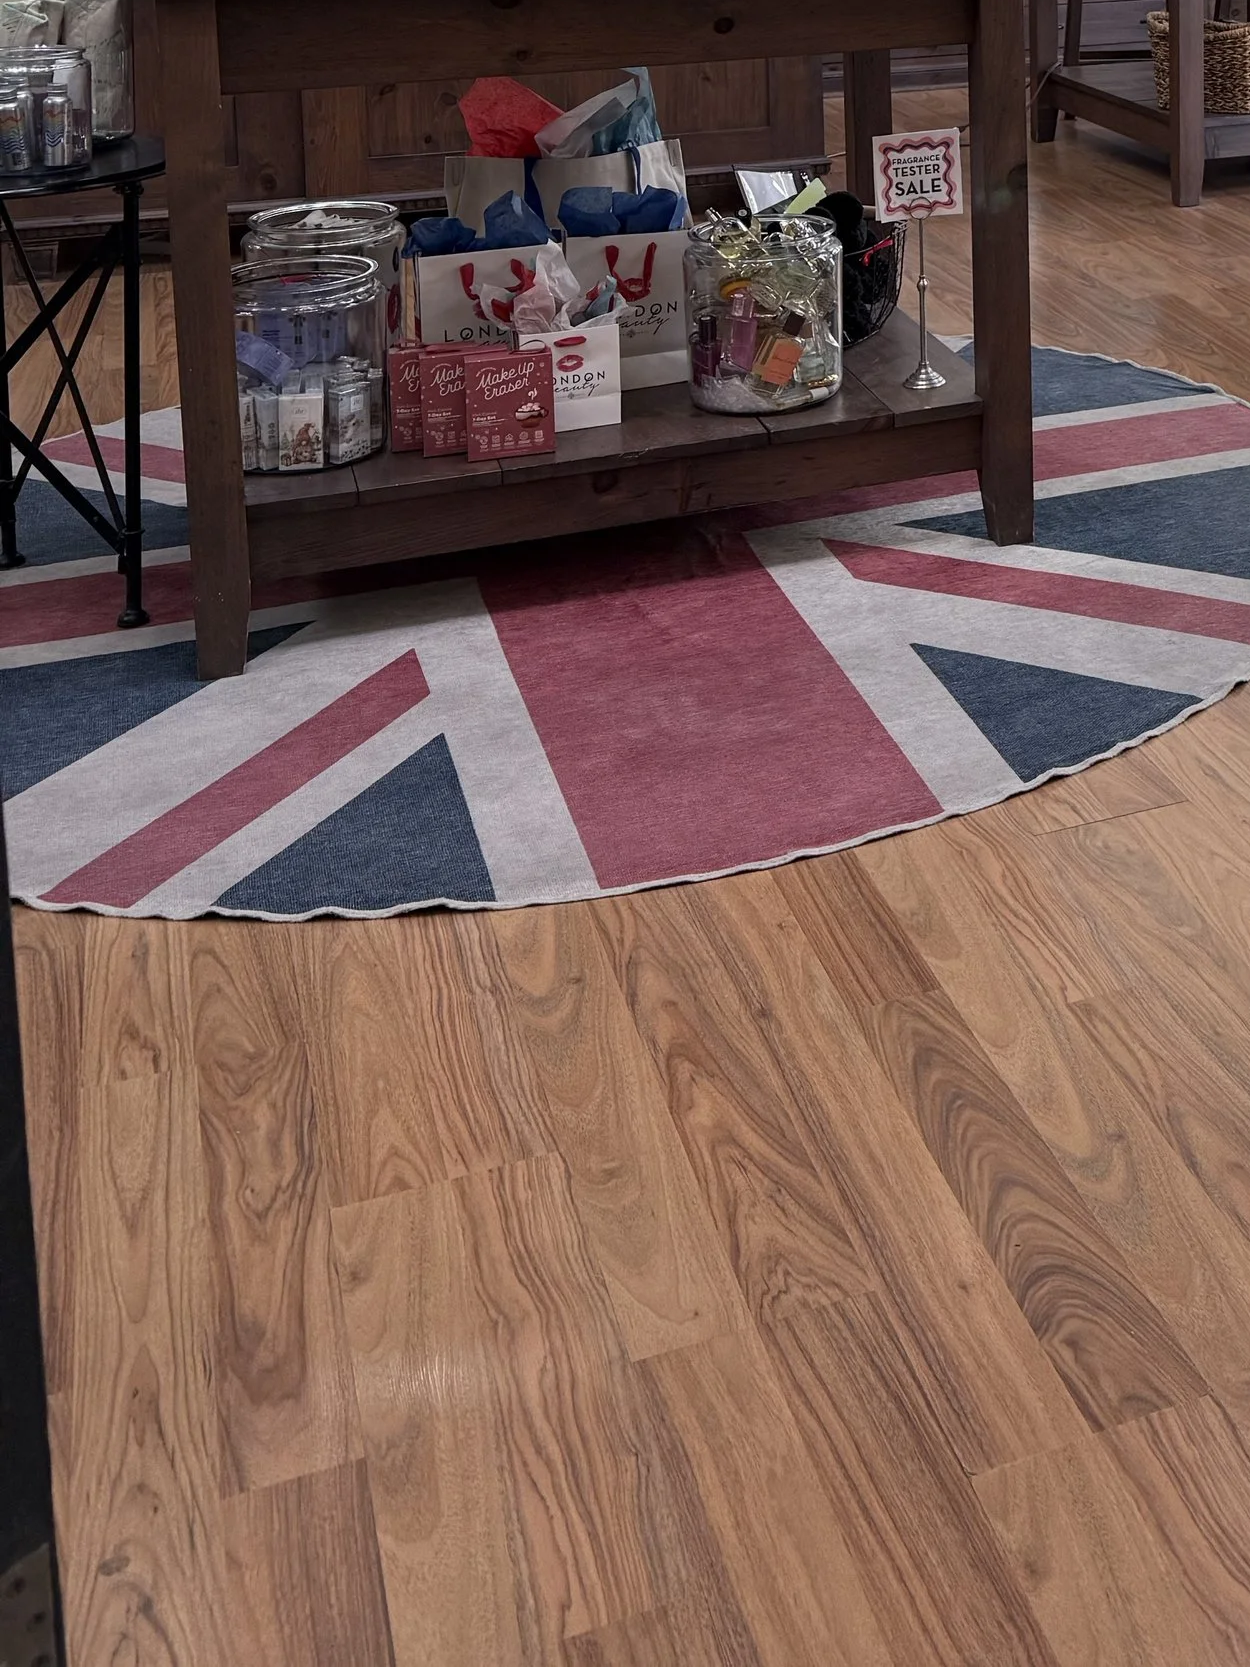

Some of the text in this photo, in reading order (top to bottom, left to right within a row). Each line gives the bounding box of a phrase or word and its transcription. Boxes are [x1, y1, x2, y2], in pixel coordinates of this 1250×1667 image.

[892, 154, 941, 165] FRAGRANCE
[893, 164, 940, 177] TESTER
[895, 178, 942, 196] SALE
[635, 301, 678, 317] DON
[431, 364, 464, 387] Mak
[439, 382, 465, 396] Era
[484, 377, 529, 400] Eraser
[555, 381, 600, 397] eauty
